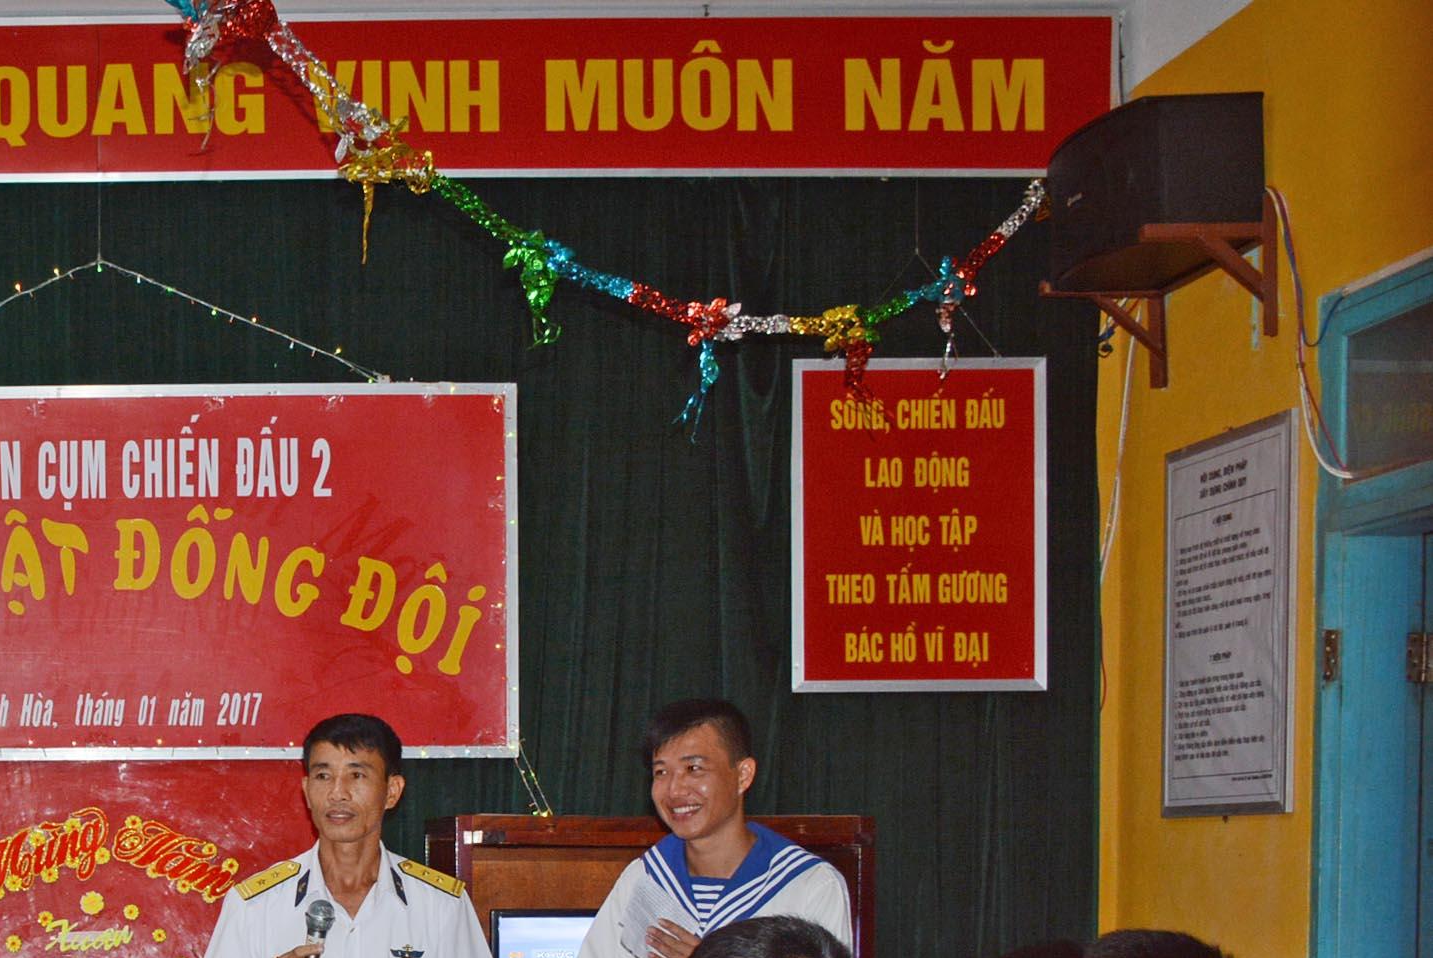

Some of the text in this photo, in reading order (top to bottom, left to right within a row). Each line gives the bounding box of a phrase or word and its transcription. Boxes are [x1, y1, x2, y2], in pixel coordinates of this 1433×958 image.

[545, 40, 793, 132] MUÔN
[845, 40, 1045, 132] NĂM
[896, 388, 956, 429] CHIẾN
[965, 387, 1005, 429] ĐẤU
[38, 439, 106, 511] CỤM
[122, 414, 219, 499] CHIẾN
[235, 415, 299, 498] ĐẤU
[311, 438, 332, 498] 2
[864, 451, 970, 493] LAO ĐỘNG
[859, 508, 978, 552] VÀ HỌC TẬP
[826, 562, 1008, 604] THEO TẤM GƯƠNG
[845, 621, 989, 668] BÁC HỒ VĨ ĐẠI
[19, 691, 59, 730] Hòa,
[74, 691, 126, 727] tháng
[137, 695, 158, 727] 01
[167, 691, 206, 727] năm
[216, 692, 264, 727] 2017
